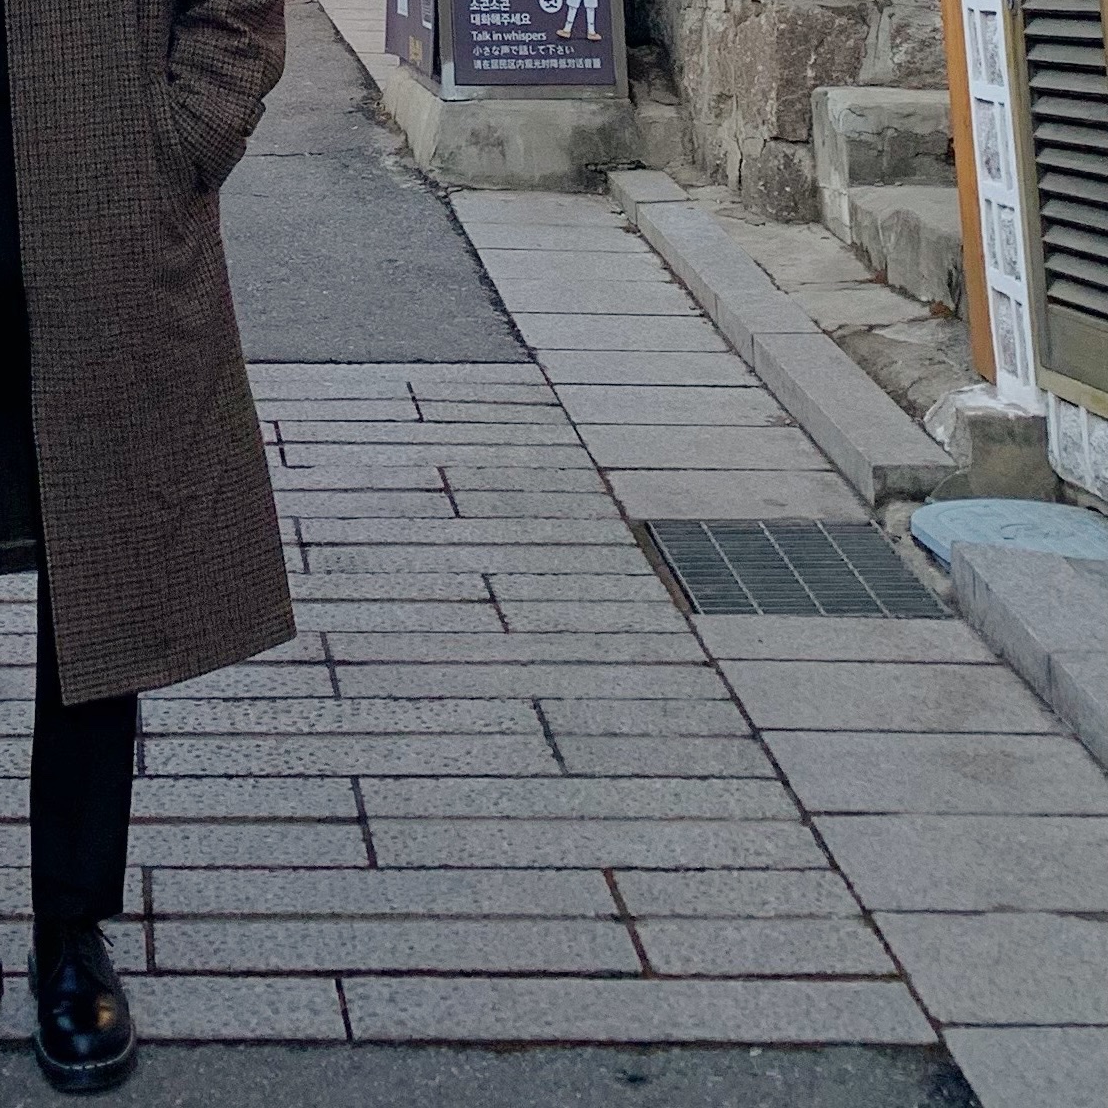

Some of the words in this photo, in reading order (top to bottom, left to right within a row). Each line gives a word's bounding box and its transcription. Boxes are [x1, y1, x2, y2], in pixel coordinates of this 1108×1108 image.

[470, 13, 532, 26] 대화해주세요
[470, 30, 491, 41] Talk
[492, 30, 502, 41] in
[503, 30, 547, 42] whispers
